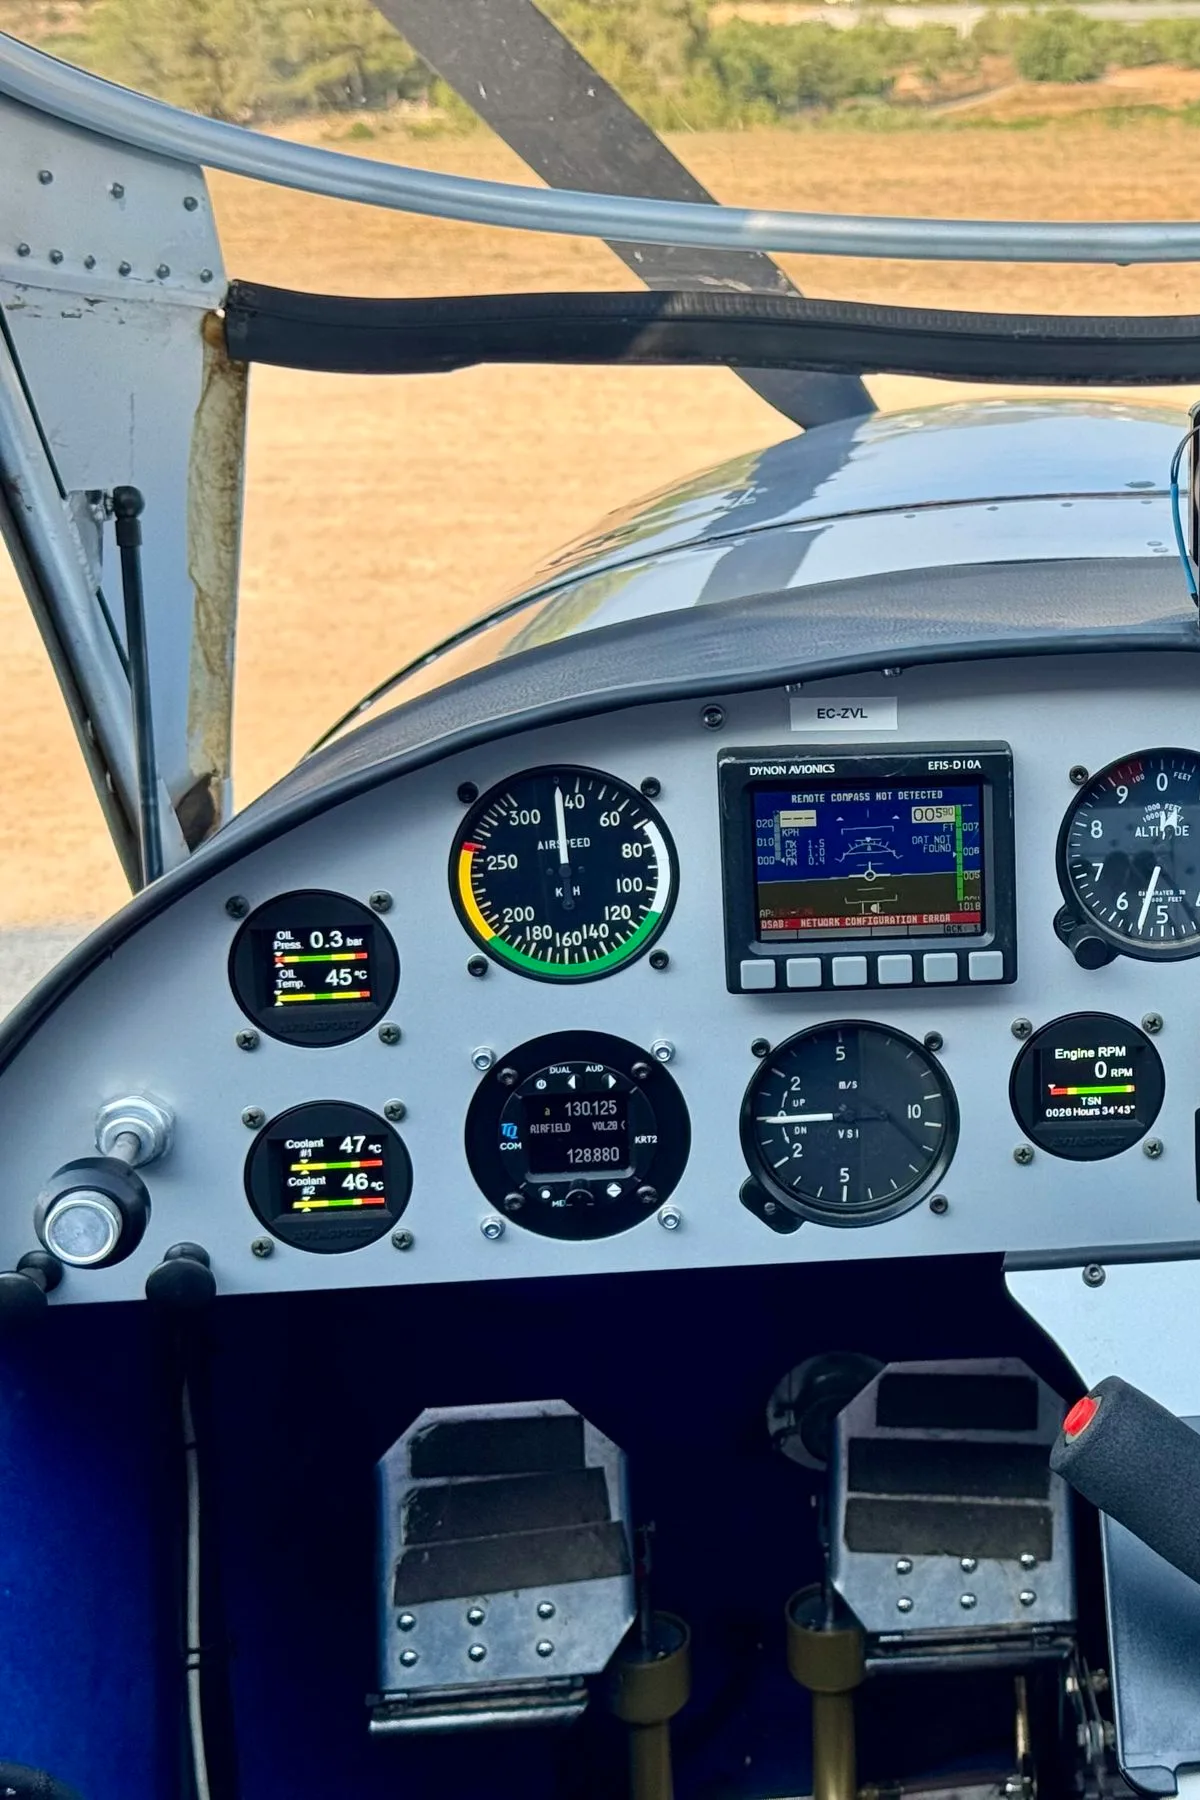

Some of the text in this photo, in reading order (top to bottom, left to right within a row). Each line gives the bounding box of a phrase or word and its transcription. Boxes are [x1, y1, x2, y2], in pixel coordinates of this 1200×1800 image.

[817, 708, 867, 719] EC-ZVL
[750, 764, 835, 775] DYNON AVIONICS
[928, 760, 981, 770] EFIS-D10A
[1132, 773, 1192, 783] 100 FEET
[1157, 773, 1168, 792] 0
[564, 794, 585, 809] 40
[791, 790, 943, 803] REMOTE COMPASS NOT DETECTED
[1117, 785, 1128, 804] 9
[510, 809, 541, 825] 300
[600, 812, 620, 826] 60
[782, 828, 799, 837] KPH
[1091, 820, 1102, 838] 8
[934, 835, 951, 843] NOT
[622, 843, 642, 858] 80
[923, 844, 951, 853] FOUND
[487, 854, 518, 870] 250
[1092, 863, 1104, 882] 7
[616, 878, 642, 893] 100
[1116, 892, 1128, 910] 6
[503, 907, 534, 923] 200
[605, 905, 631, 920] 120
[1157, 905, 1168, 924] 5
[801, 914, 950, 927] NETWORK CONFIGURATION ERROR
[277, 931, 294, 940] OIL
[526, 925, 552, 941] 180
[583, 924, 609, 939] 140
[273, 941, 304, 950] Press.
[310, 931, 363, 948] 0.3 bar
[556, 932, 582, 947] 160
[279, 970, 296, 978] OIL
[325, 969, 352, 986] 45
[276, 979, 306, 989] Temp.
[836, 1046, 845, 1061] 5
[1055, 1047, 1126, 1061] Engine RPM
[550, 1066, 571, 1074] DUAL
[1095, 1061, 1132, 1078] 0 RPM
[791, 1077, 801, 1091] 2
[839, 1081, 858, 1089] m/s
[565, 1100, 617, 1116] 130.125
[793, 1099, 805, 1107] UP
[1081, 1097, 1101, 1105] TSN
[908, 1104, 921, 1119] 10
[1046, 1105, 1135, 1117] 0026 Hours 34'43"
[530, 1124, 571, 1133] AIRFIELD
[838, 1130, 859, 1138] VSI
[285, 1139, 324, 1149] Coolant
[340, 1136, 366, 1153] 47
[500, 1142, 521, 1150] COM
[792, 1143, 803, 1158] 2
[300, 1149, 312, 1157] #1
[567, 1147, 619, 1163] 128.880
[288, 1177, 326, 1186] Coolant
[342, 1173, 368, 1190] 46
[840, 1168, 849, 1182] 5
[303, 1186, 315, 1194] #2
